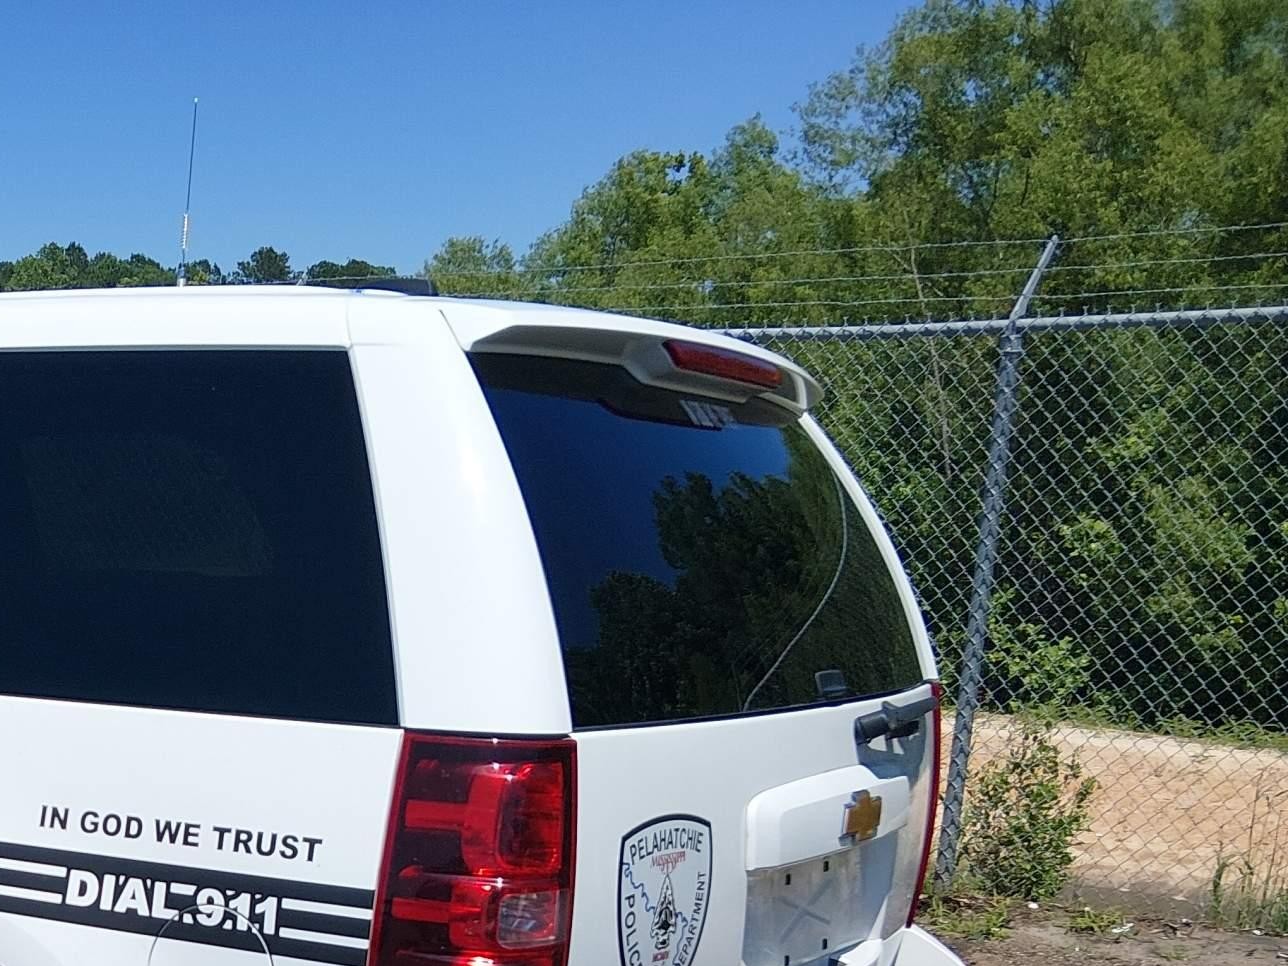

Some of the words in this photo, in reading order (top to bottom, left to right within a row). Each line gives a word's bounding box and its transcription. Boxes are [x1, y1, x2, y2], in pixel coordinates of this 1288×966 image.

[39, 804, 70, 830] IN
[79, 810, 143, 840] GOD
[155, 818, 201, 848] WE
[212, 826, 323, 862] TRUST
[629, 827, 705, 866] PELAHATCHIE
[65, 868, 181, 921] DIAL
[195, 886, 279, 935] 911
